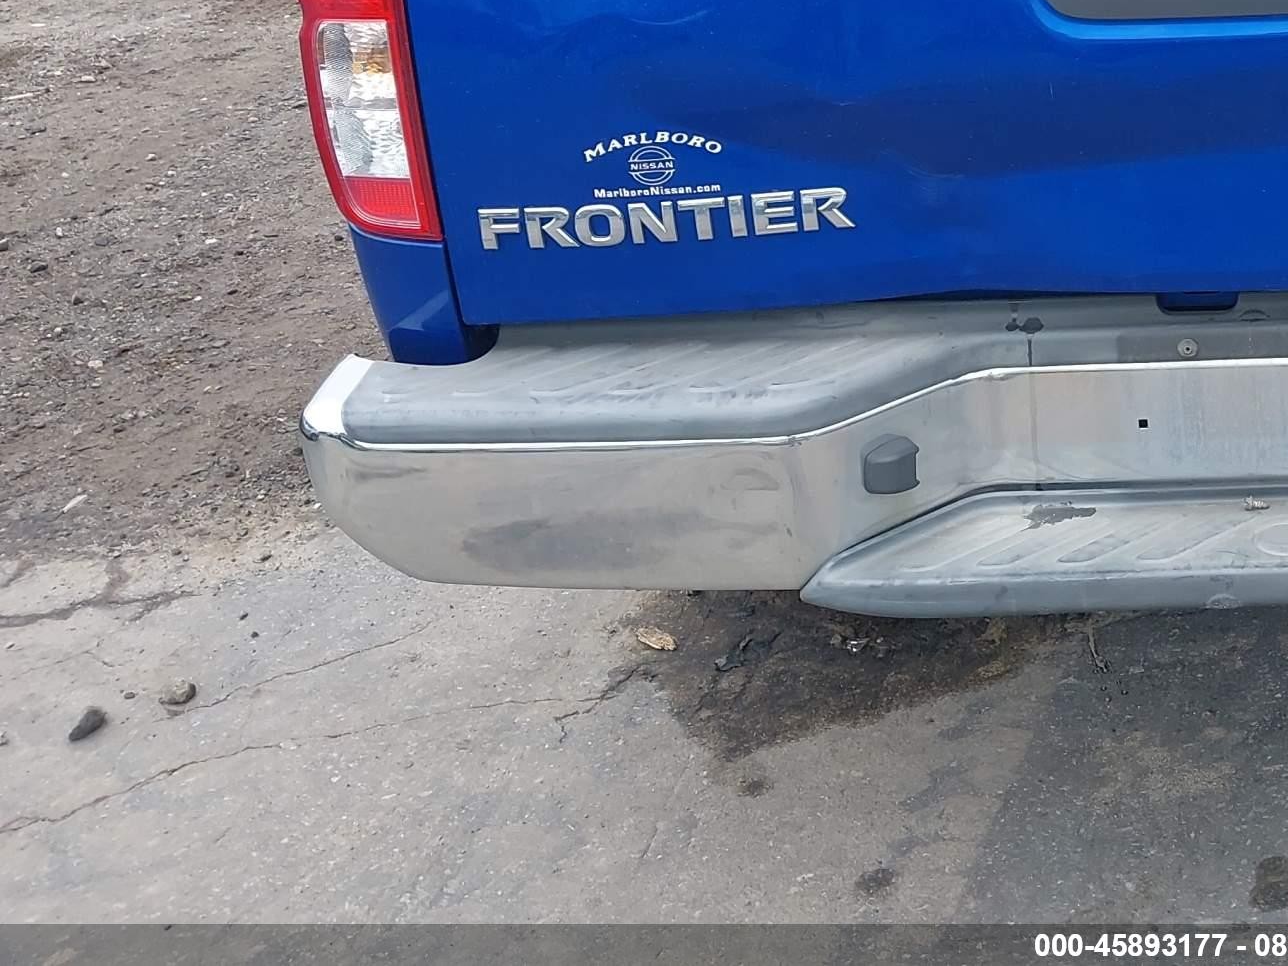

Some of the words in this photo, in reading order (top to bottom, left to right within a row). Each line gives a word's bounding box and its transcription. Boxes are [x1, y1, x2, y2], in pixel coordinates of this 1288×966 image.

[583, 131, 722, 162] MARLBORO
[630, 160, 674, 172] NISSAN
[593, 183, 721, 199] MarlboroNissan.com
[477, 187, 857, 251] FRONTIER
